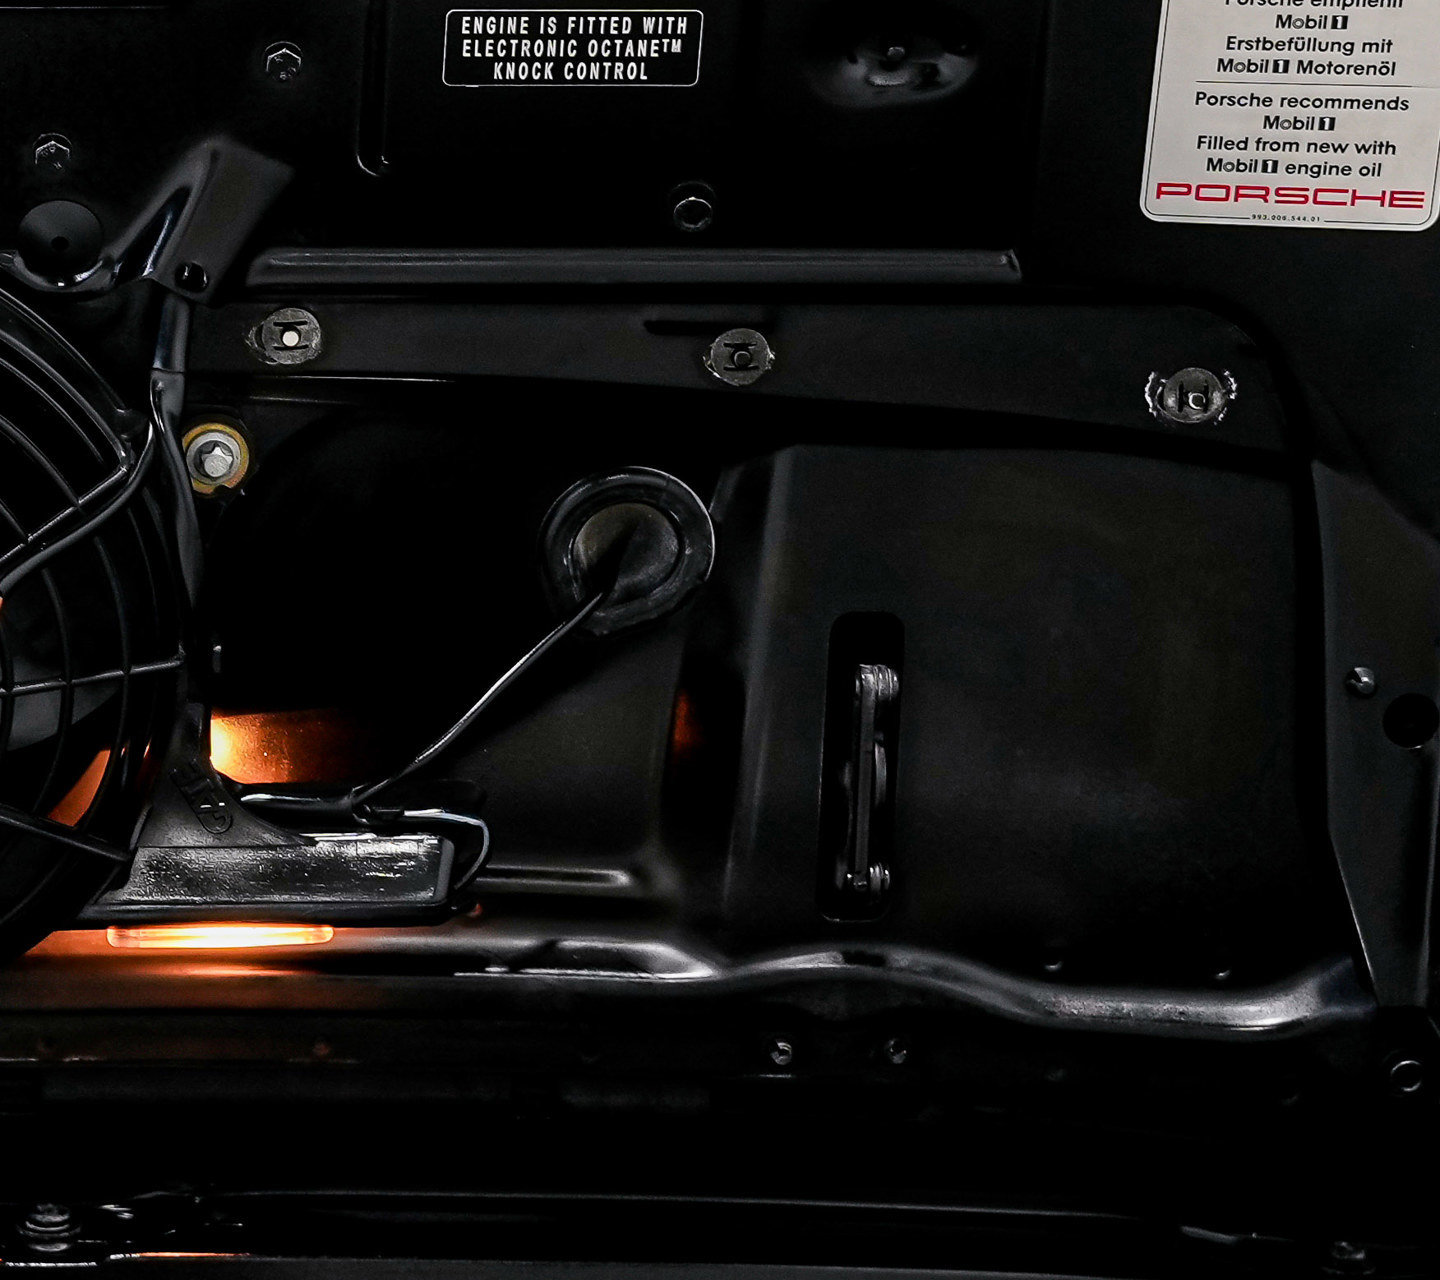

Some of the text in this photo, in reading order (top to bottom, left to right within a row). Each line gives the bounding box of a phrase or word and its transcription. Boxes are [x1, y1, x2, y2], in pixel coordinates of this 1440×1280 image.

[462, 17, 686, 34] ENGINE IS FITTED WITH
[463, 39, 577, 57] ELECTRONIC
[1226, 36, 1393, 56] Erstbefüllung mit
[494, 62, 647, 79] KNOCK CONTROL
[1297, 60, 1396, 75] Motorenöl
[1196, 92, 1409, 110] Porsche recommends
[1197, 136, 1396, 155] Filled from new with
[1285, 164, 1352, 178] engine
[1359, 163, 1381, 176] oil
[1156, 183, 1425, 208] PORSCHE
